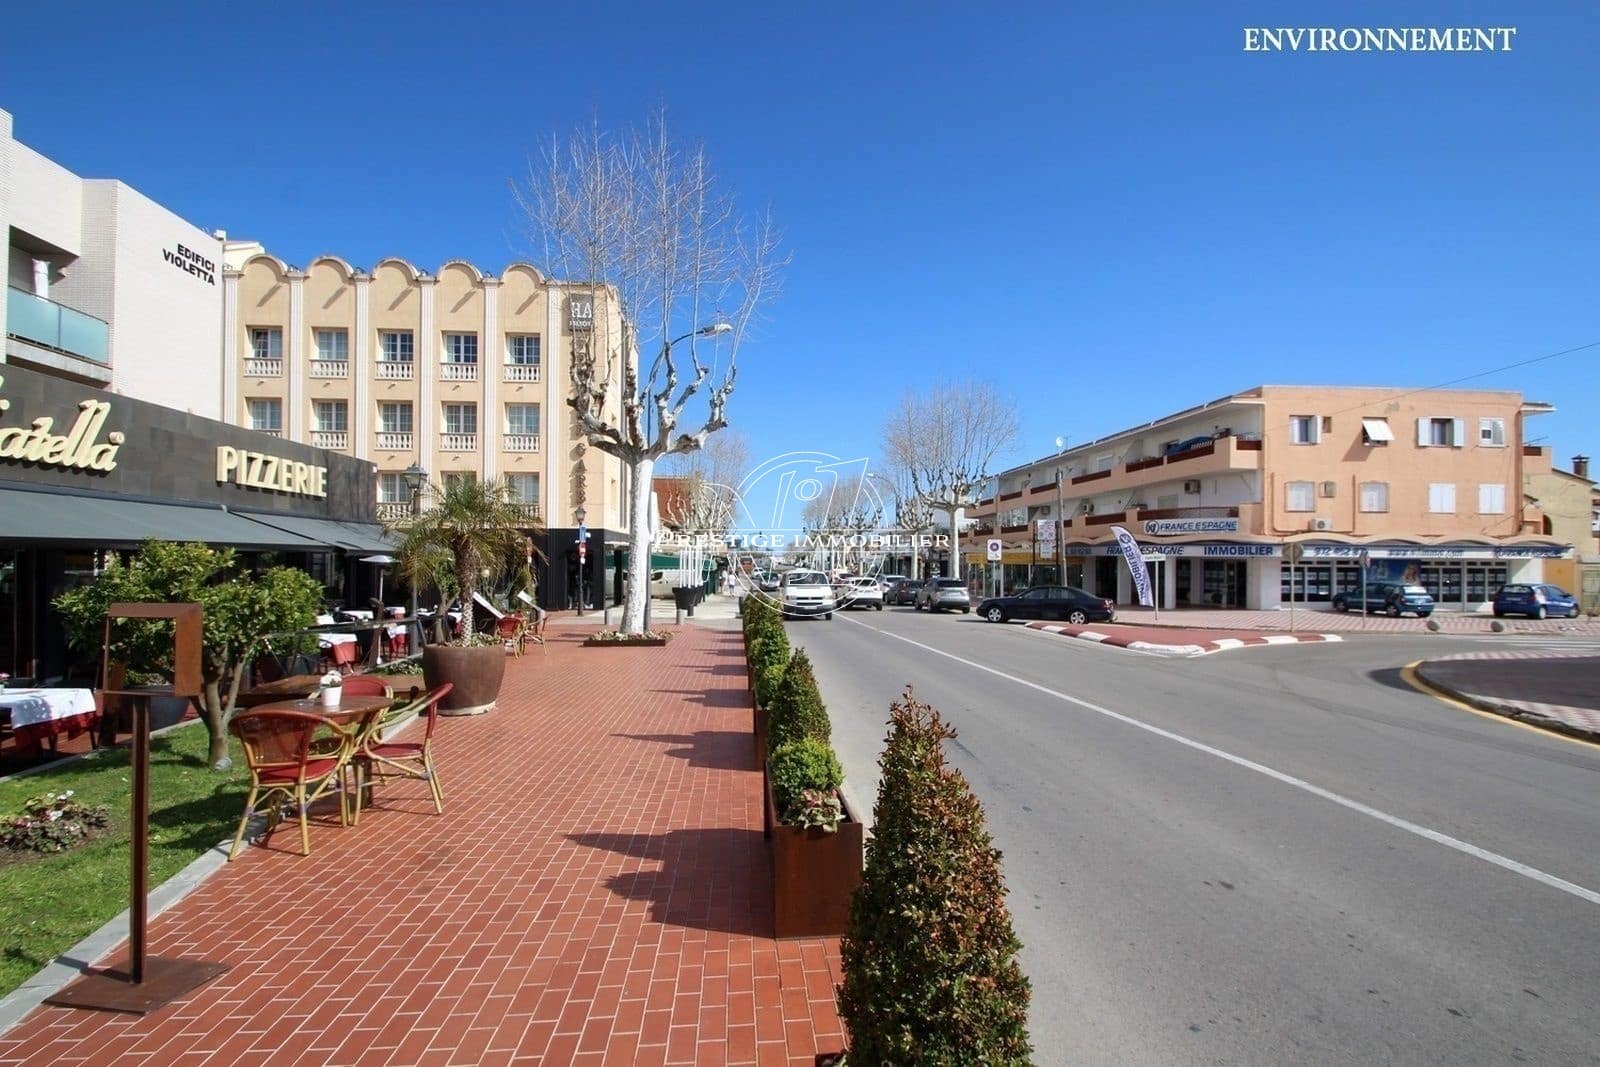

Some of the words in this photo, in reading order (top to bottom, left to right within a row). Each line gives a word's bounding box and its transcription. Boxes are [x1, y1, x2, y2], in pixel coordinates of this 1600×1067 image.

[162, 248, 216, 286] VIOLETTA
[177, 243, 215, 273] EDIFICI
[216, 446, 327, 497] PIZZERIE
[1161, 521, 1193, 531] FRANCE
[1195, 520, 1237, 530] ESPAGNE
[1203, 545, 1274, 556] IMMOBILIER
